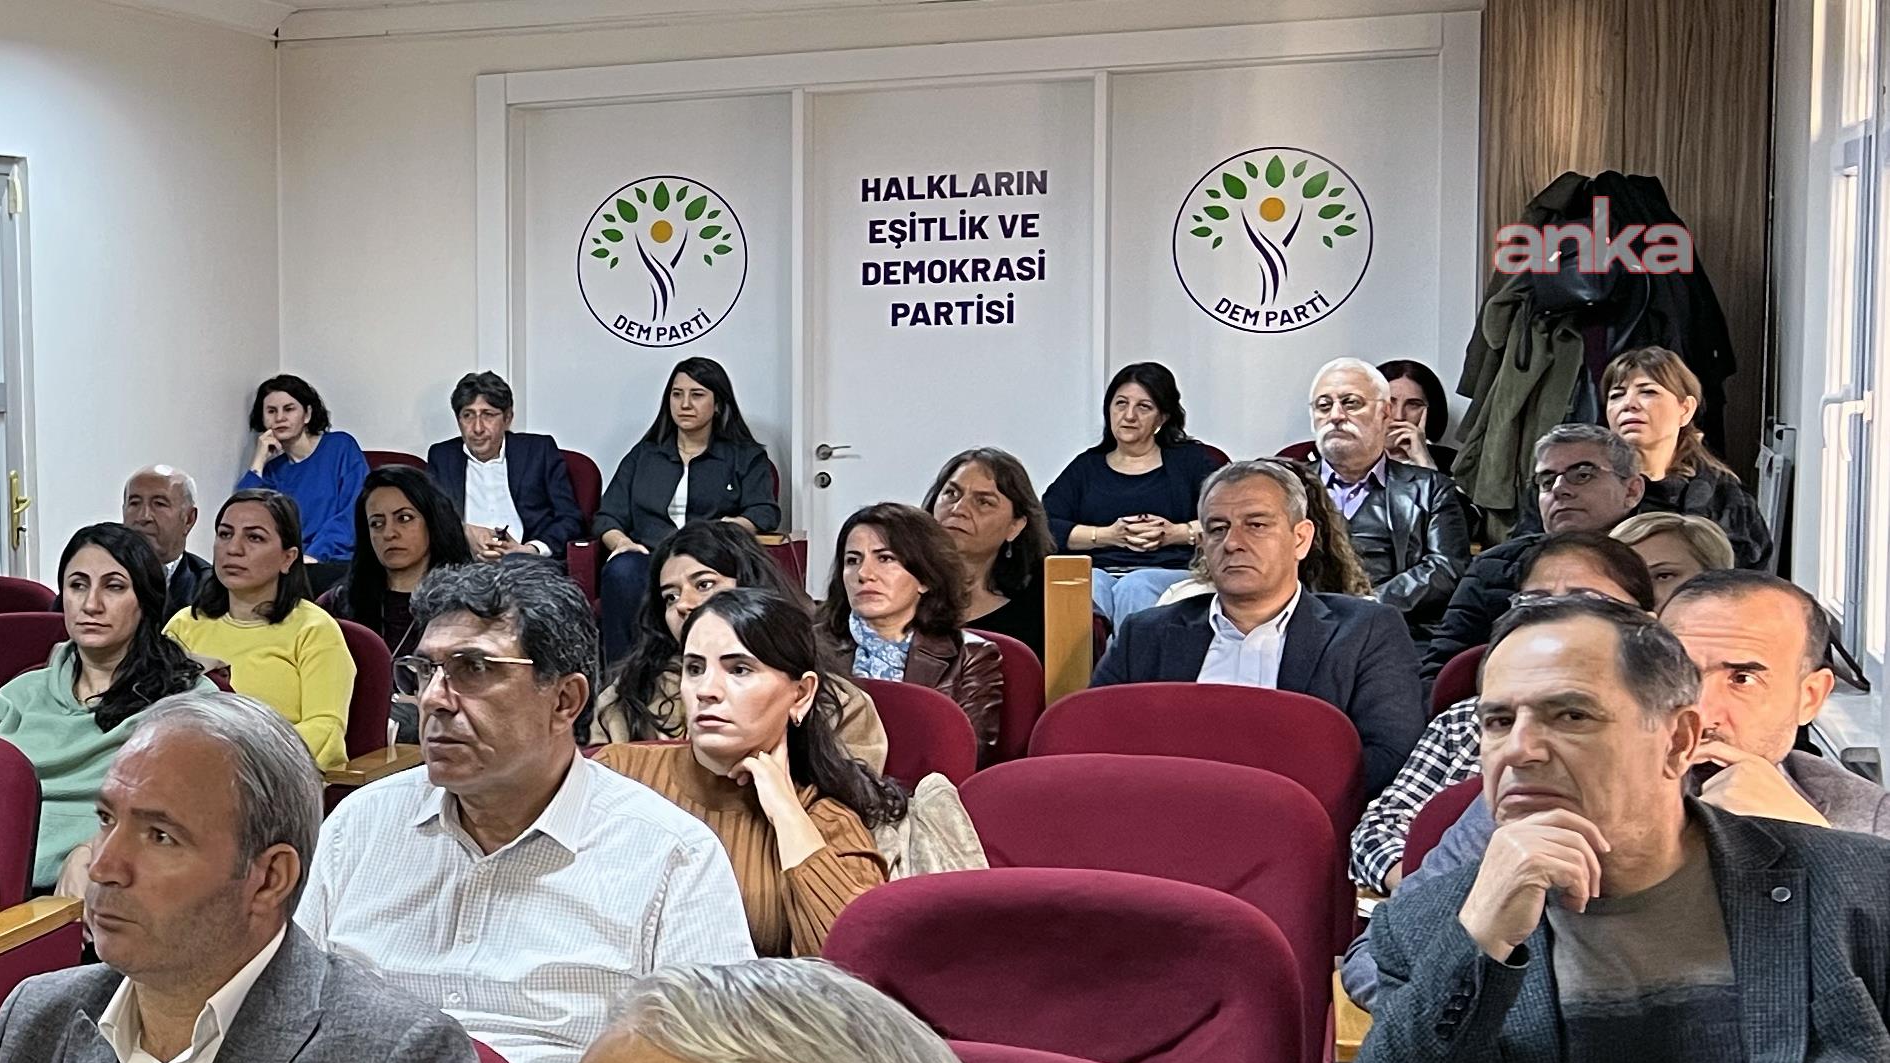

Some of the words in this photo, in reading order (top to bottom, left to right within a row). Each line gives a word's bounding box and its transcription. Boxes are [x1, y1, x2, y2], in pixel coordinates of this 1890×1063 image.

[861, 169, 1048, 202] HALKLARIN
[868, 208, 990, 249] EŞİTLİK
[997, 213, 1040, 239] VE
[861, 248, 1046, 286] DEMOKRASİ
[613, 314, 652, 341] DEM
[656, 307, 712, 342] PARTİ
[891, 292, 1014, 327] PARTİSİ
[1214, 297, 1260, 326] DEM
[1265, 289, 1330, 327] PARTİ
